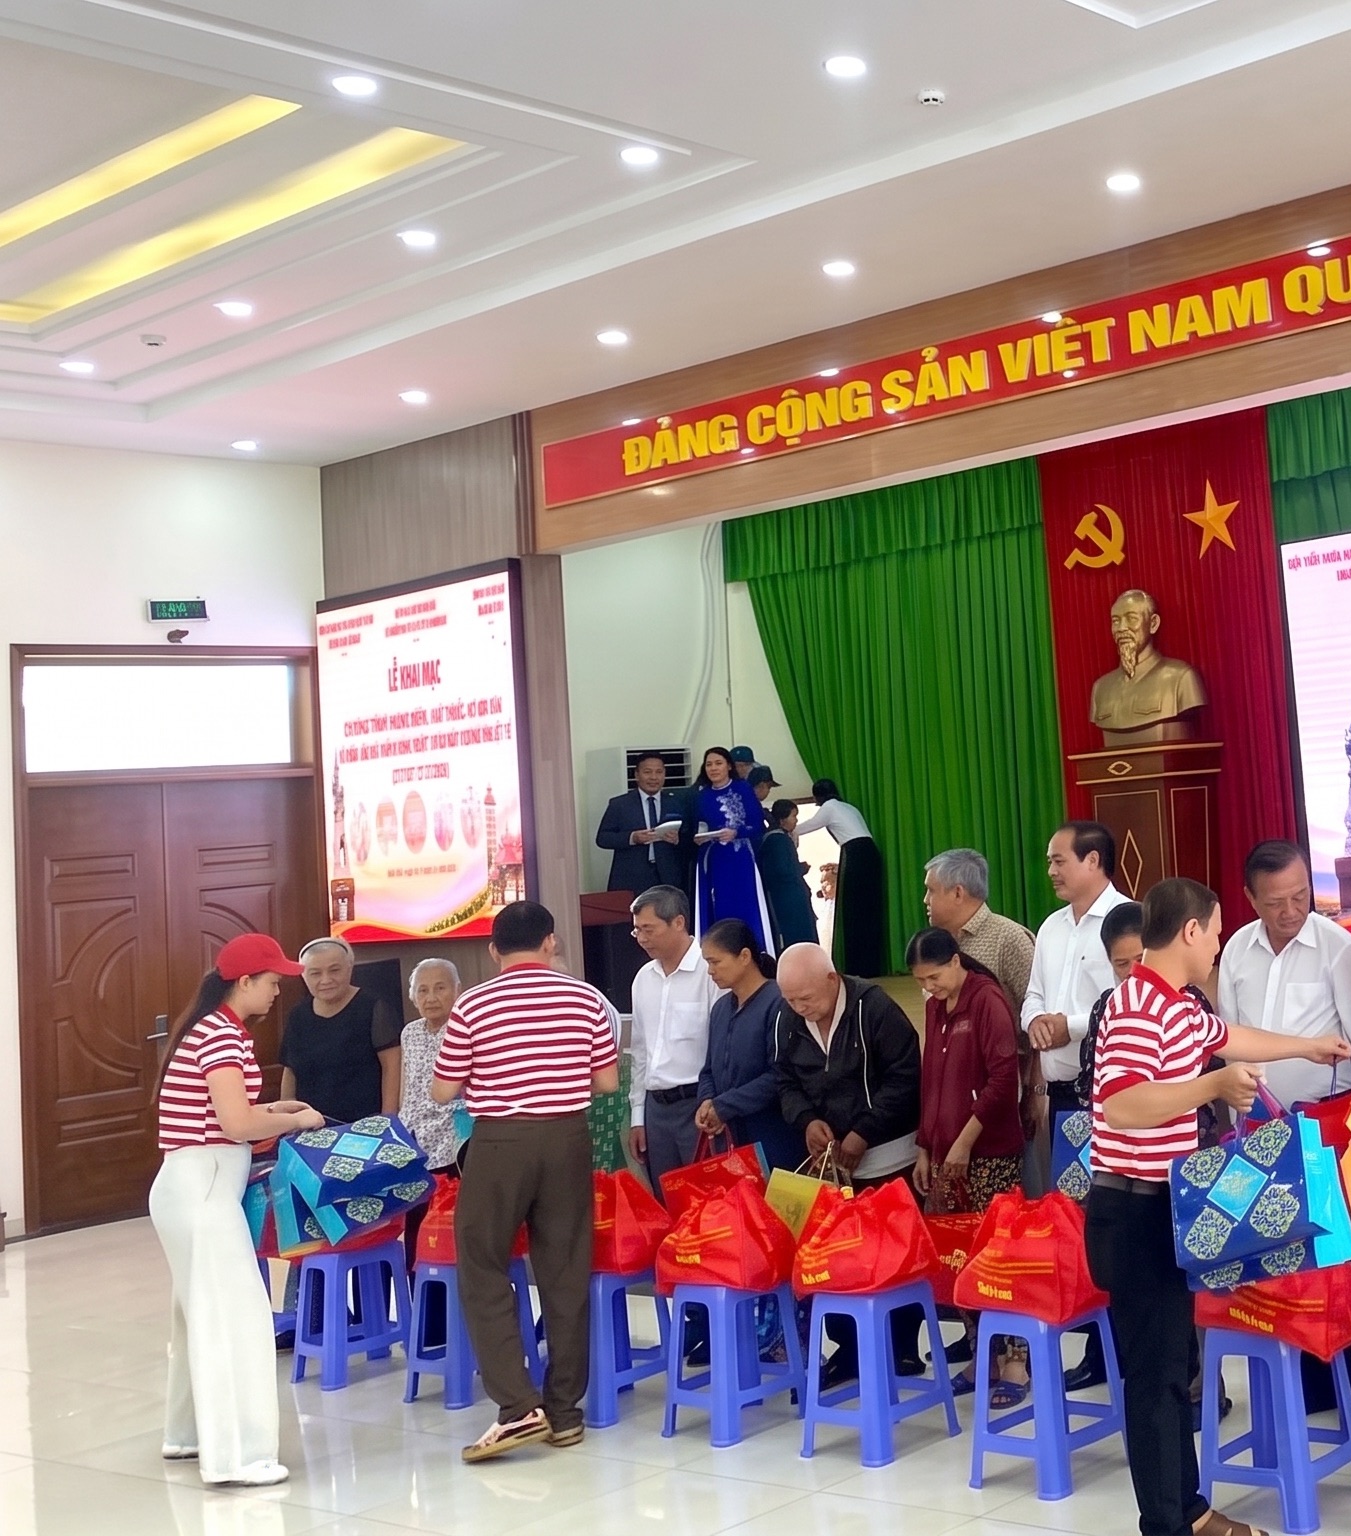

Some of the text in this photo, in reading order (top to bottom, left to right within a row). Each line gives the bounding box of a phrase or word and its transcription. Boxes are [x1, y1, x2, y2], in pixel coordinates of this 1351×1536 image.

[622, 416, 739, 476] ĐẢNG
[746, 388, 875, 446] CỘNG
[881, 346, 991, 414] SẢN
[1128, 277, 1272, 355] NAM
